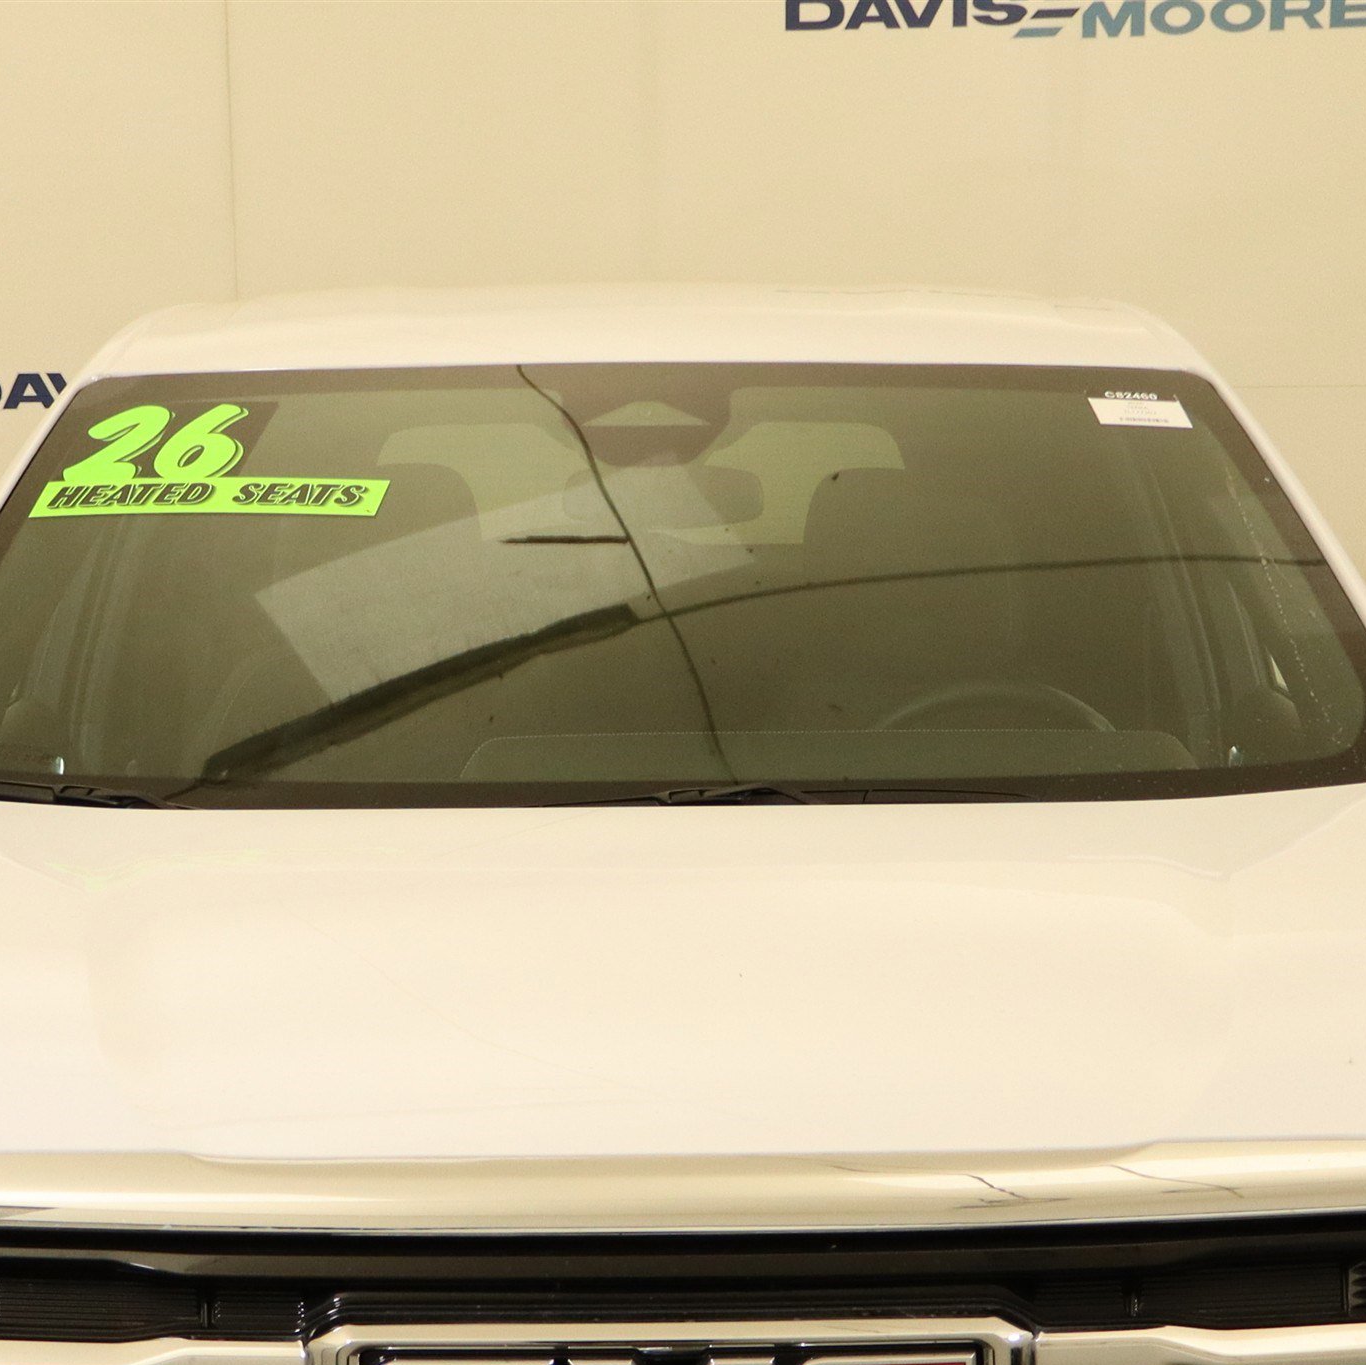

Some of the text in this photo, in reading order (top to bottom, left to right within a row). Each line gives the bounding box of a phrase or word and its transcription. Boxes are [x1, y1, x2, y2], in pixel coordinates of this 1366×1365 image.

[62, 402, 249, 481] 26
[46, 482, 370, 509] HEATED SEATS
